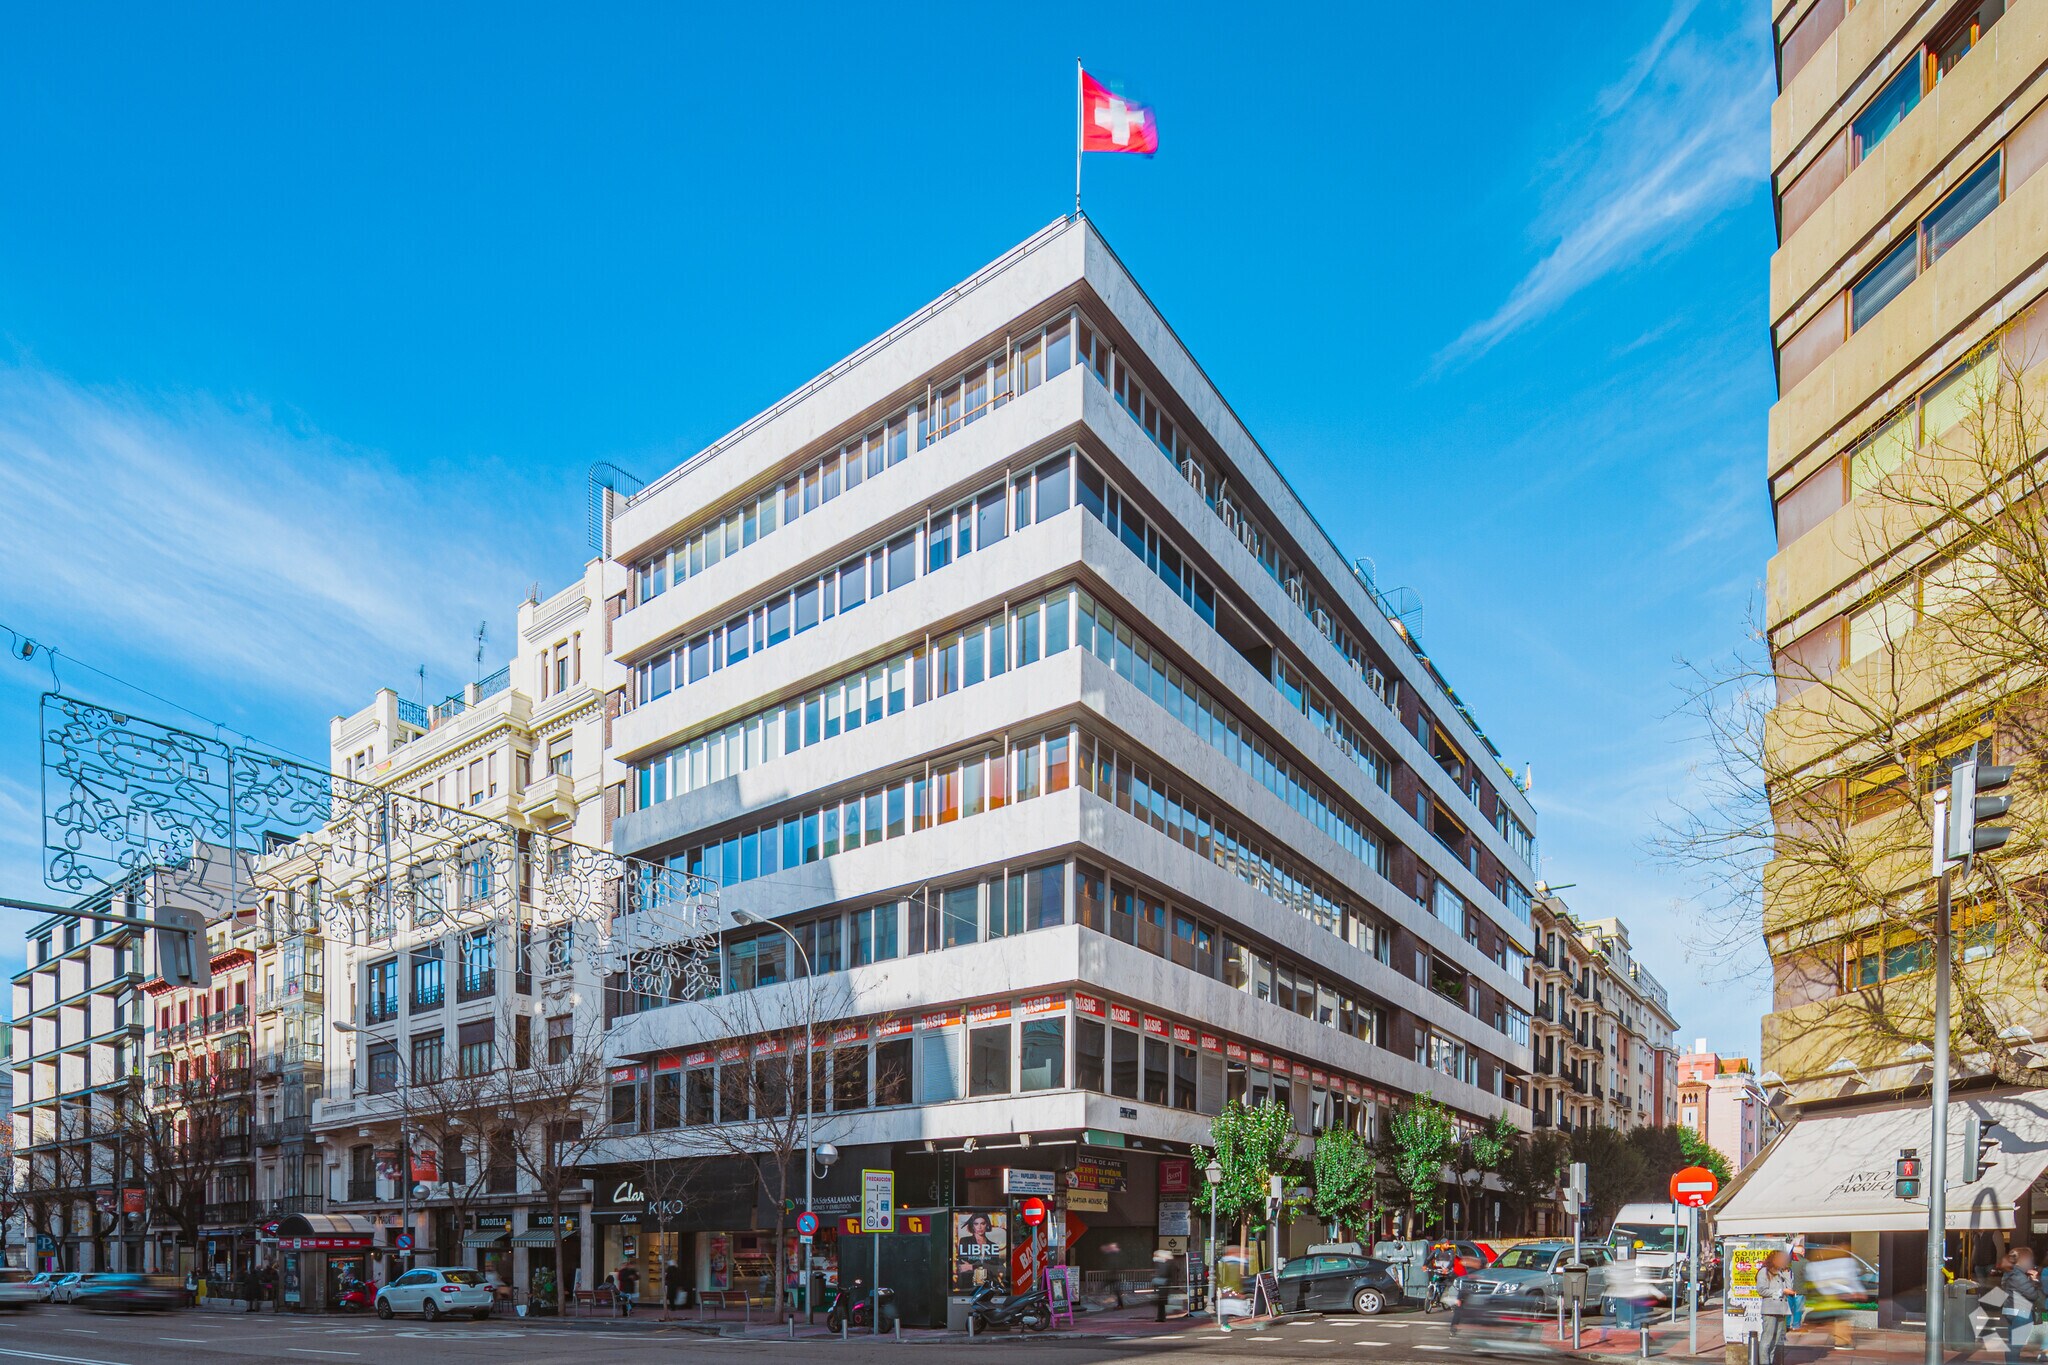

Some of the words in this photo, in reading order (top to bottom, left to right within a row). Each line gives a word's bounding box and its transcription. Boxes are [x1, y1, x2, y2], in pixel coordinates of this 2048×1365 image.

[1021, 996, 1051, 1014] BASIC
[1075, 997, 1095, 1012] BASIC
[921, 1013, 947, 1030] BASIC
[970, 1005, 997, 1023] BASIC
[1111, 1008, 1130, 1023] BASIC
[876, 1020, 900, 1037] BASIC
[1144, 1018, 1161, 1032] BASIC
[833, 1027, 857, 1044] BASIC
[1173, 1028, 1190, 1041] BASIC
[1202, 1036, 1216, 1049] BASIC
[686, 1051, 705, 1066] BASIC
[1841, 1170, 1895, 1184] ANTO
[613, 1181, 645, 1203] Clar
[1824, 1181, 1895, 1202] PARRIEG
[648, 1199, 684, 1215] KIKO
[480, 1217, 507, 1226] RODILLA
[538, 1216, 567, 1224] RODLA
[959, 1244, 999, 1256] LIBRE
